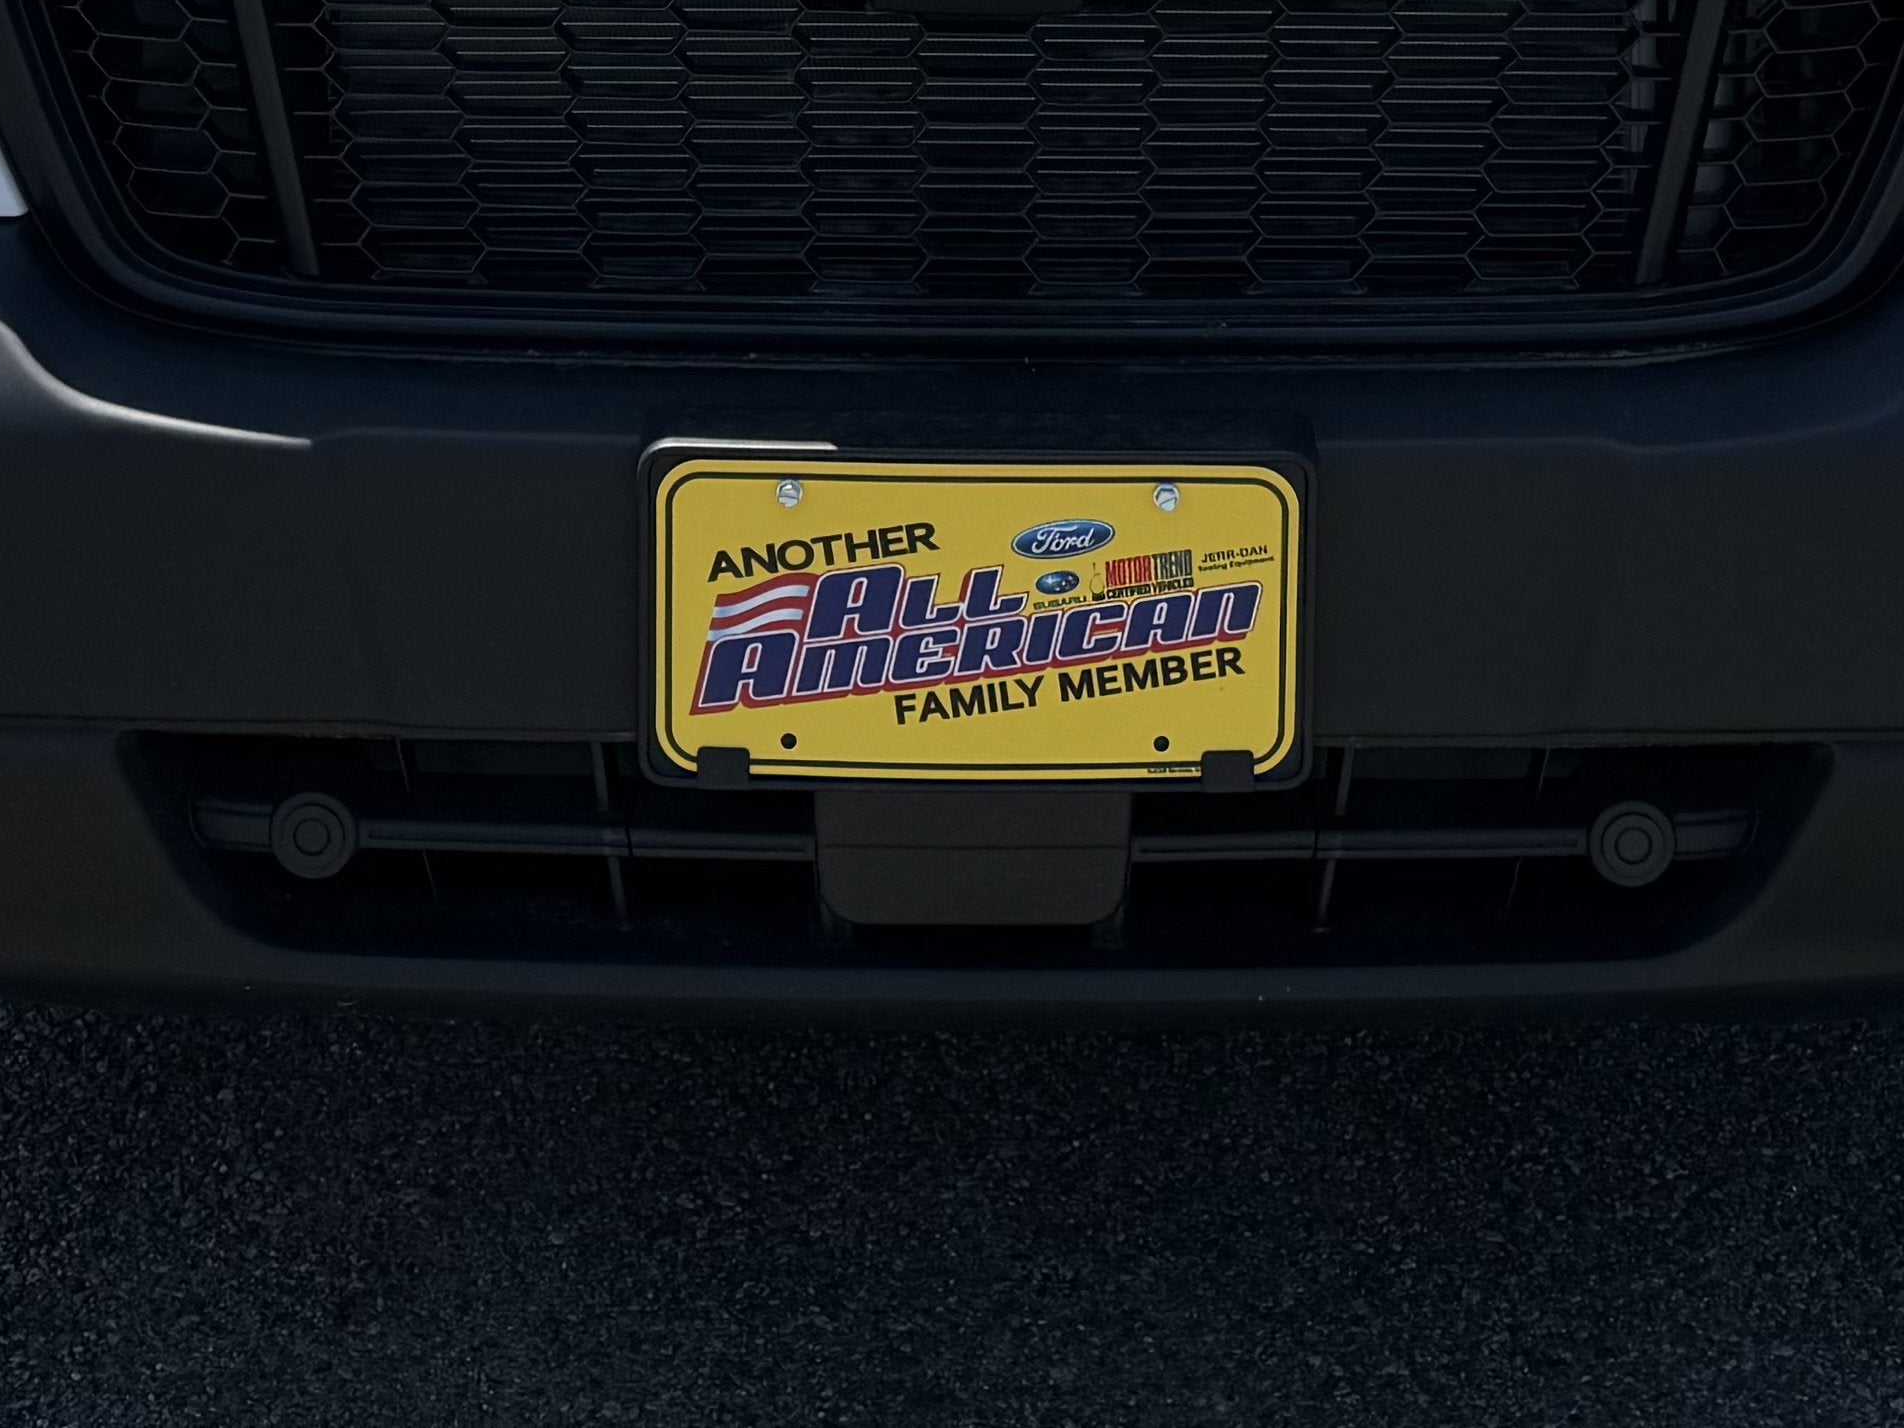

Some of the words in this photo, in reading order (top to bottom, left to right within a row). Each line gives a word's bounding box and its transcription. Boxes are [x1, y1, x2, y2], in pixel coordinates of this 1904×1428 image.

[707, 522, 941, 583] ANOTHER
[1031, 525, 1095, 554] Ford
[802, 561, 1030, 643] ALL
[692, 580, 1264, 713] AMERICAN
[894, 674, 1045, 726] FAMILY
[1058, 646, 1246, 703] MEMBER
